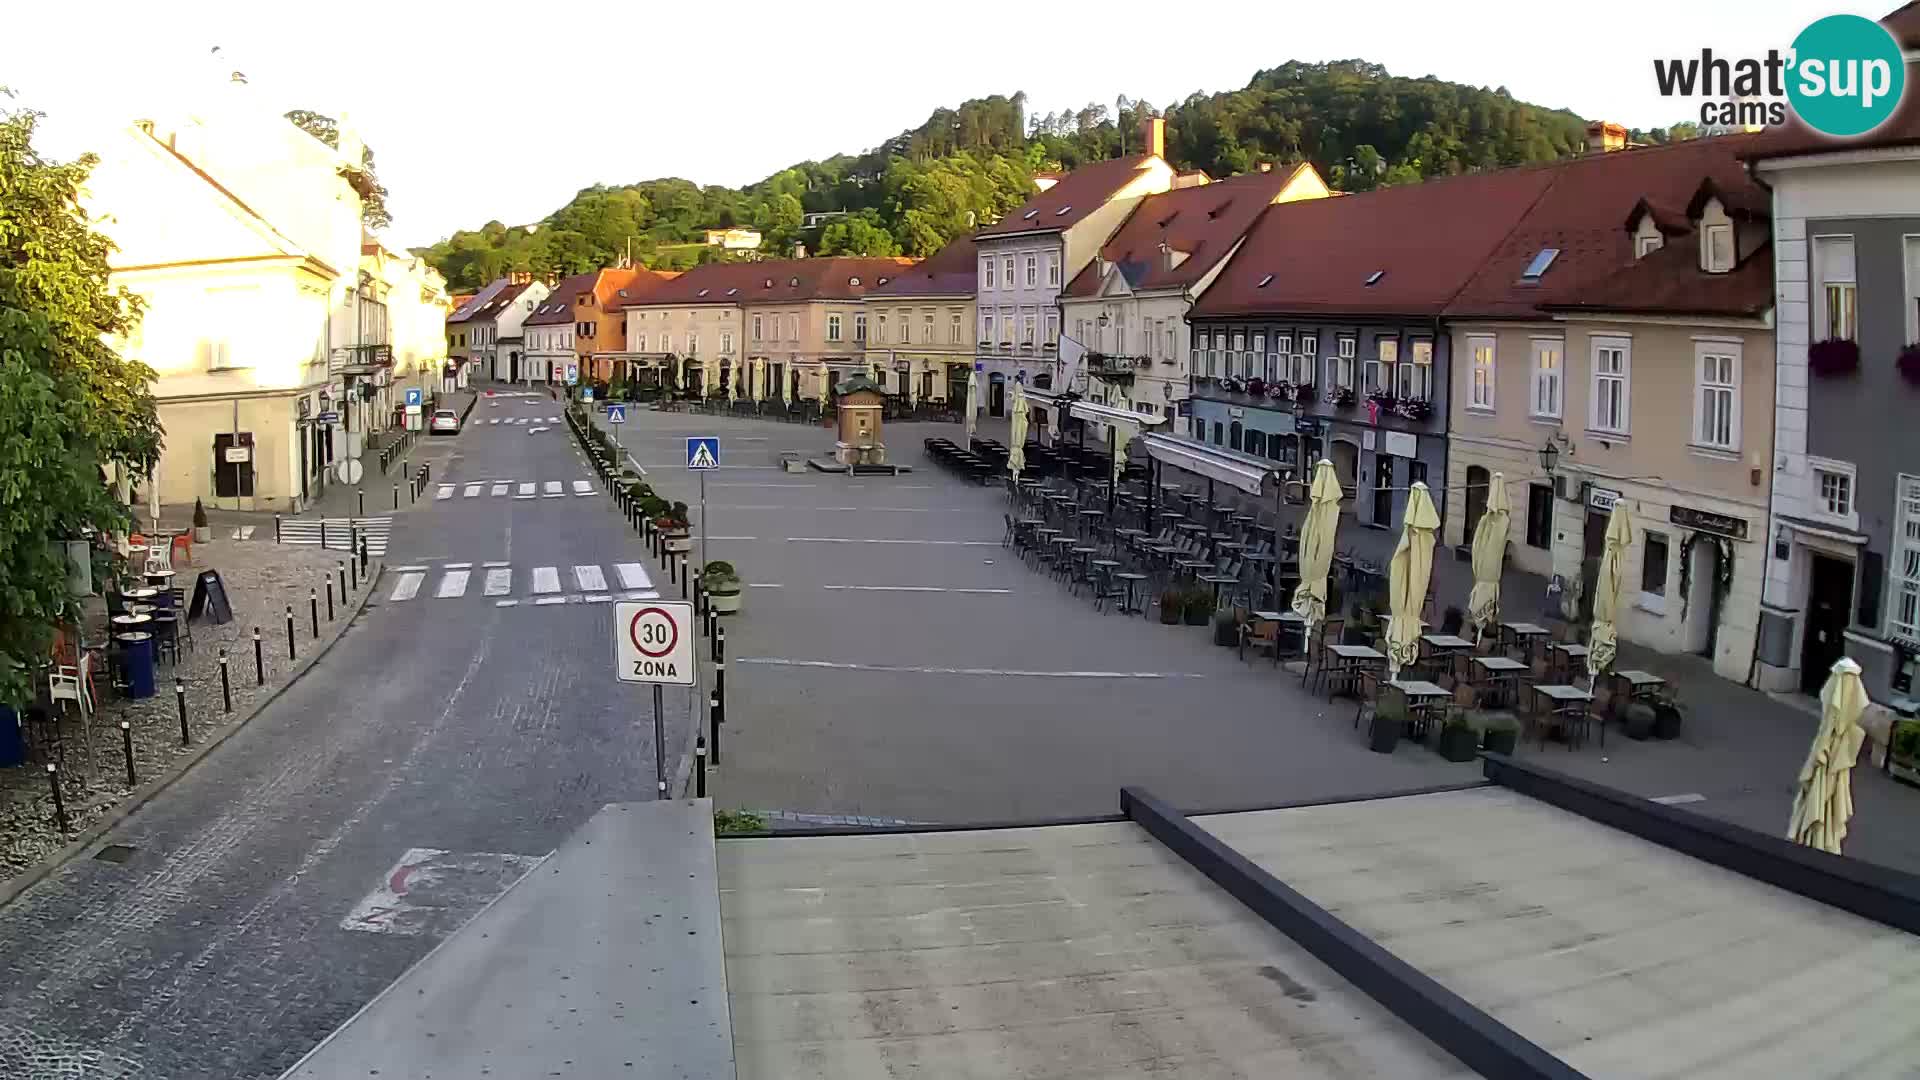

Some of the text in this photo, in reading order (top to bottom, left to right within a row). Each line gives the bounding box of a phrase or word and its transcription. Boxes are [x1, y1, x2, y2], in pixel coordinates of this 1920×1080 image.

[409, 391, 417, 403] P
[643, 623, 667, 644] 30
[633, 660, 677, 677] ZONA
